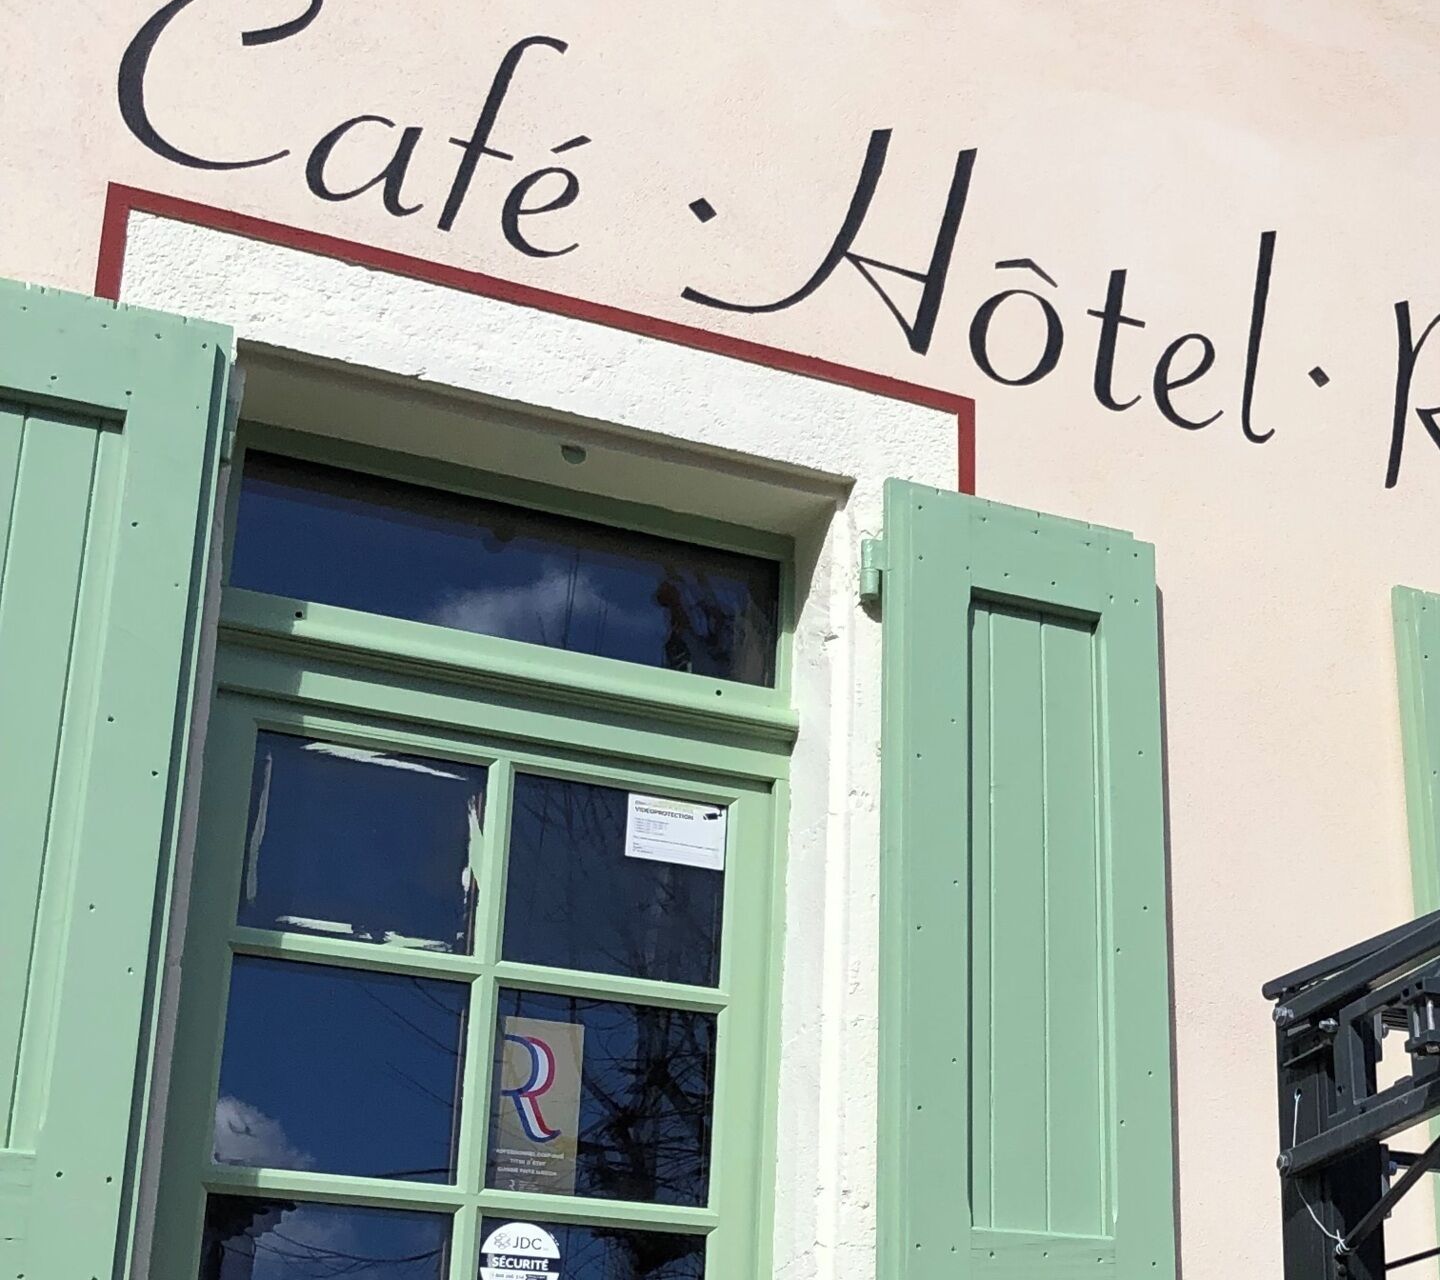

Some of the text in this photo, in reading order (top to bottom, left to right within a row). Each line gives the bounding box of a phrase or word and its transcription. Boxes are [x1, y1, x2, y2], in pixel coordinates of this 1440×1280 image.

[681, 128, 1277, 444] Hôtel
[512, 1235, 543, 1251] JDC
[492, 1256, 550, 1271] SÉCURITÉ
